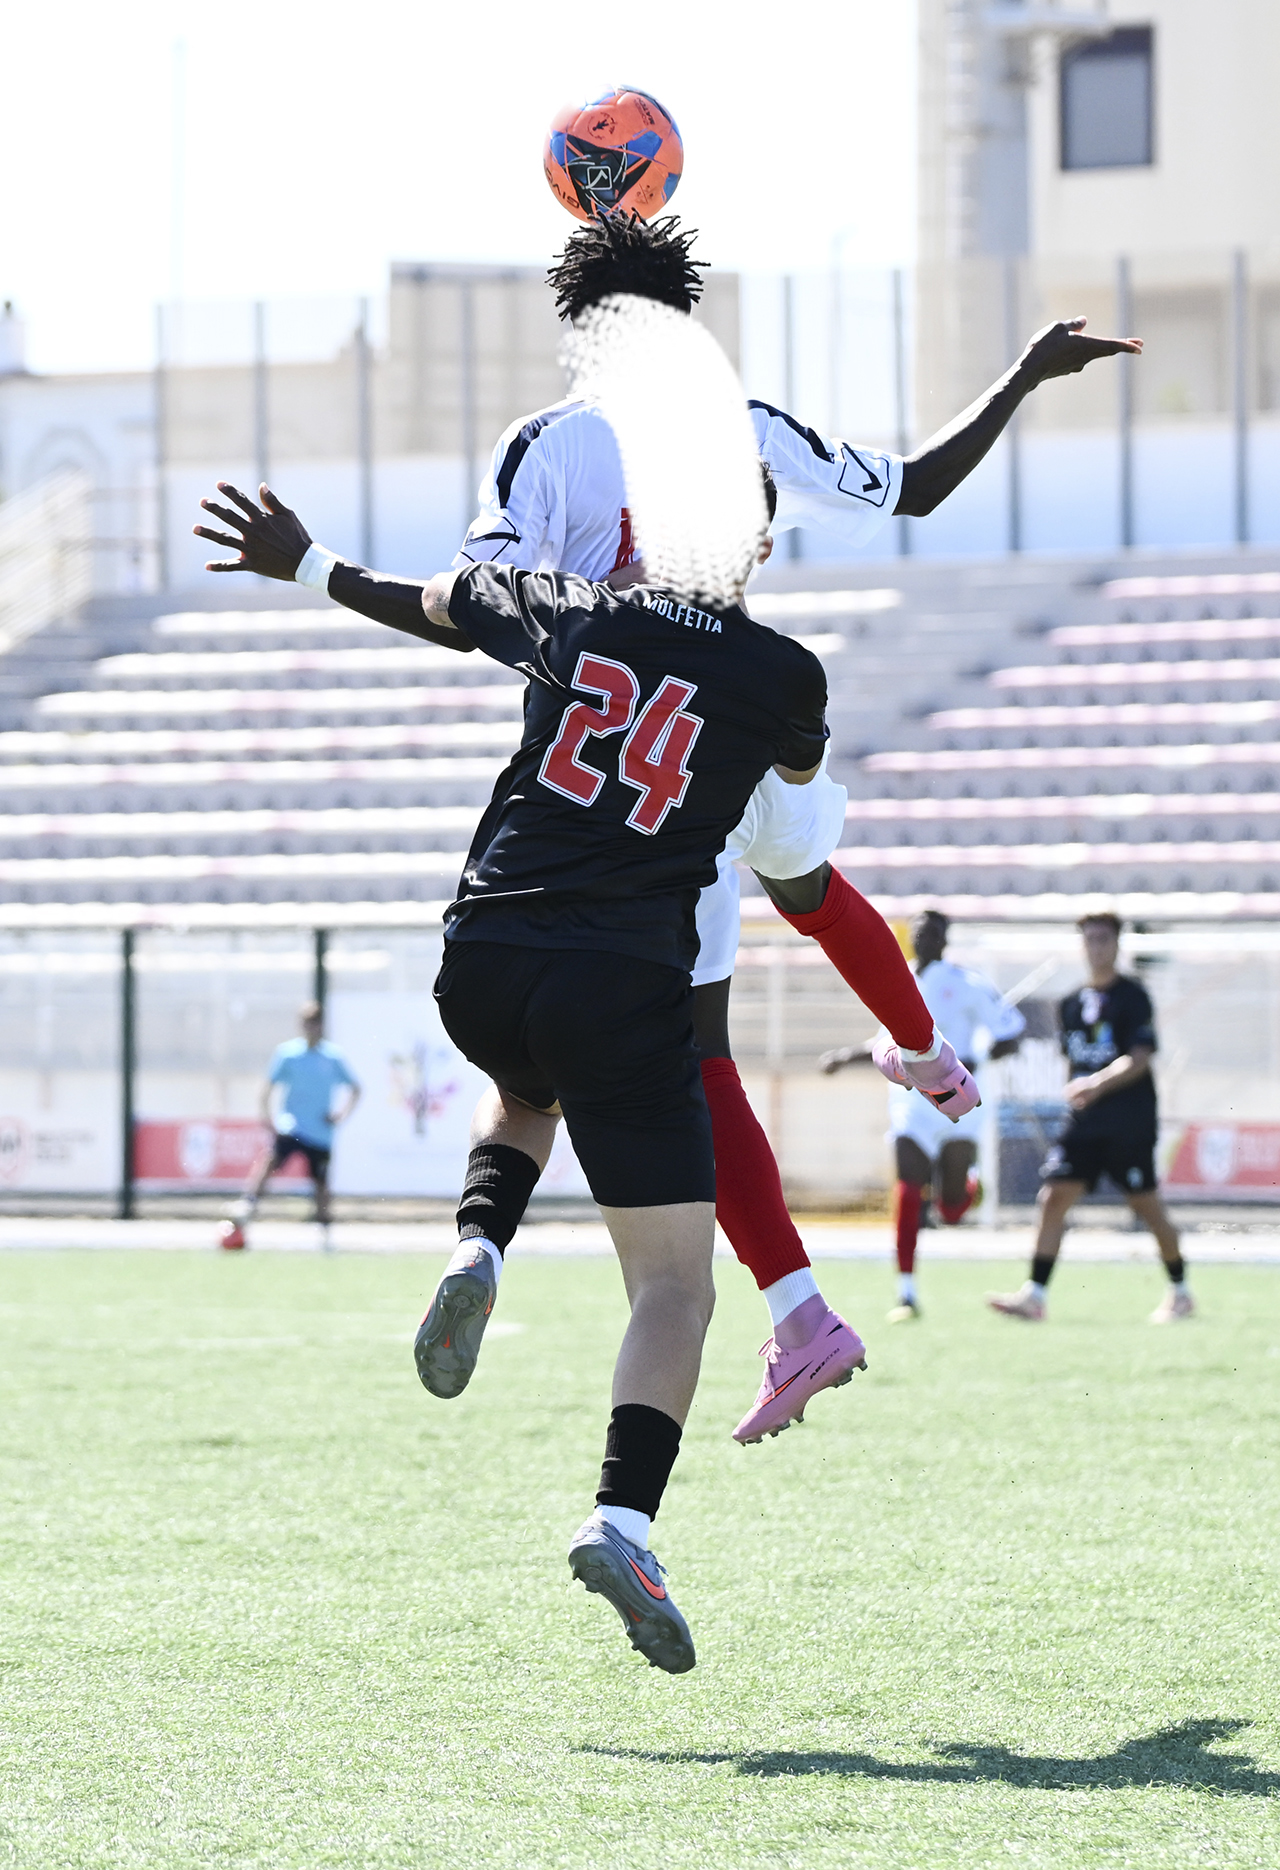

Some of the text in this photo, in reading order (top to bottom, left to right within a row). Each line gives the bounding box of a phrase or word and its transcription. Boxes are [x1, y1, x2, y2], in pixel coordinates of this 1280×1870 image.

[543, 161, 580, 209] GIVO
[642, 597, 723, 634] MOLFETTA
[537, 651, 705, 836] 24
